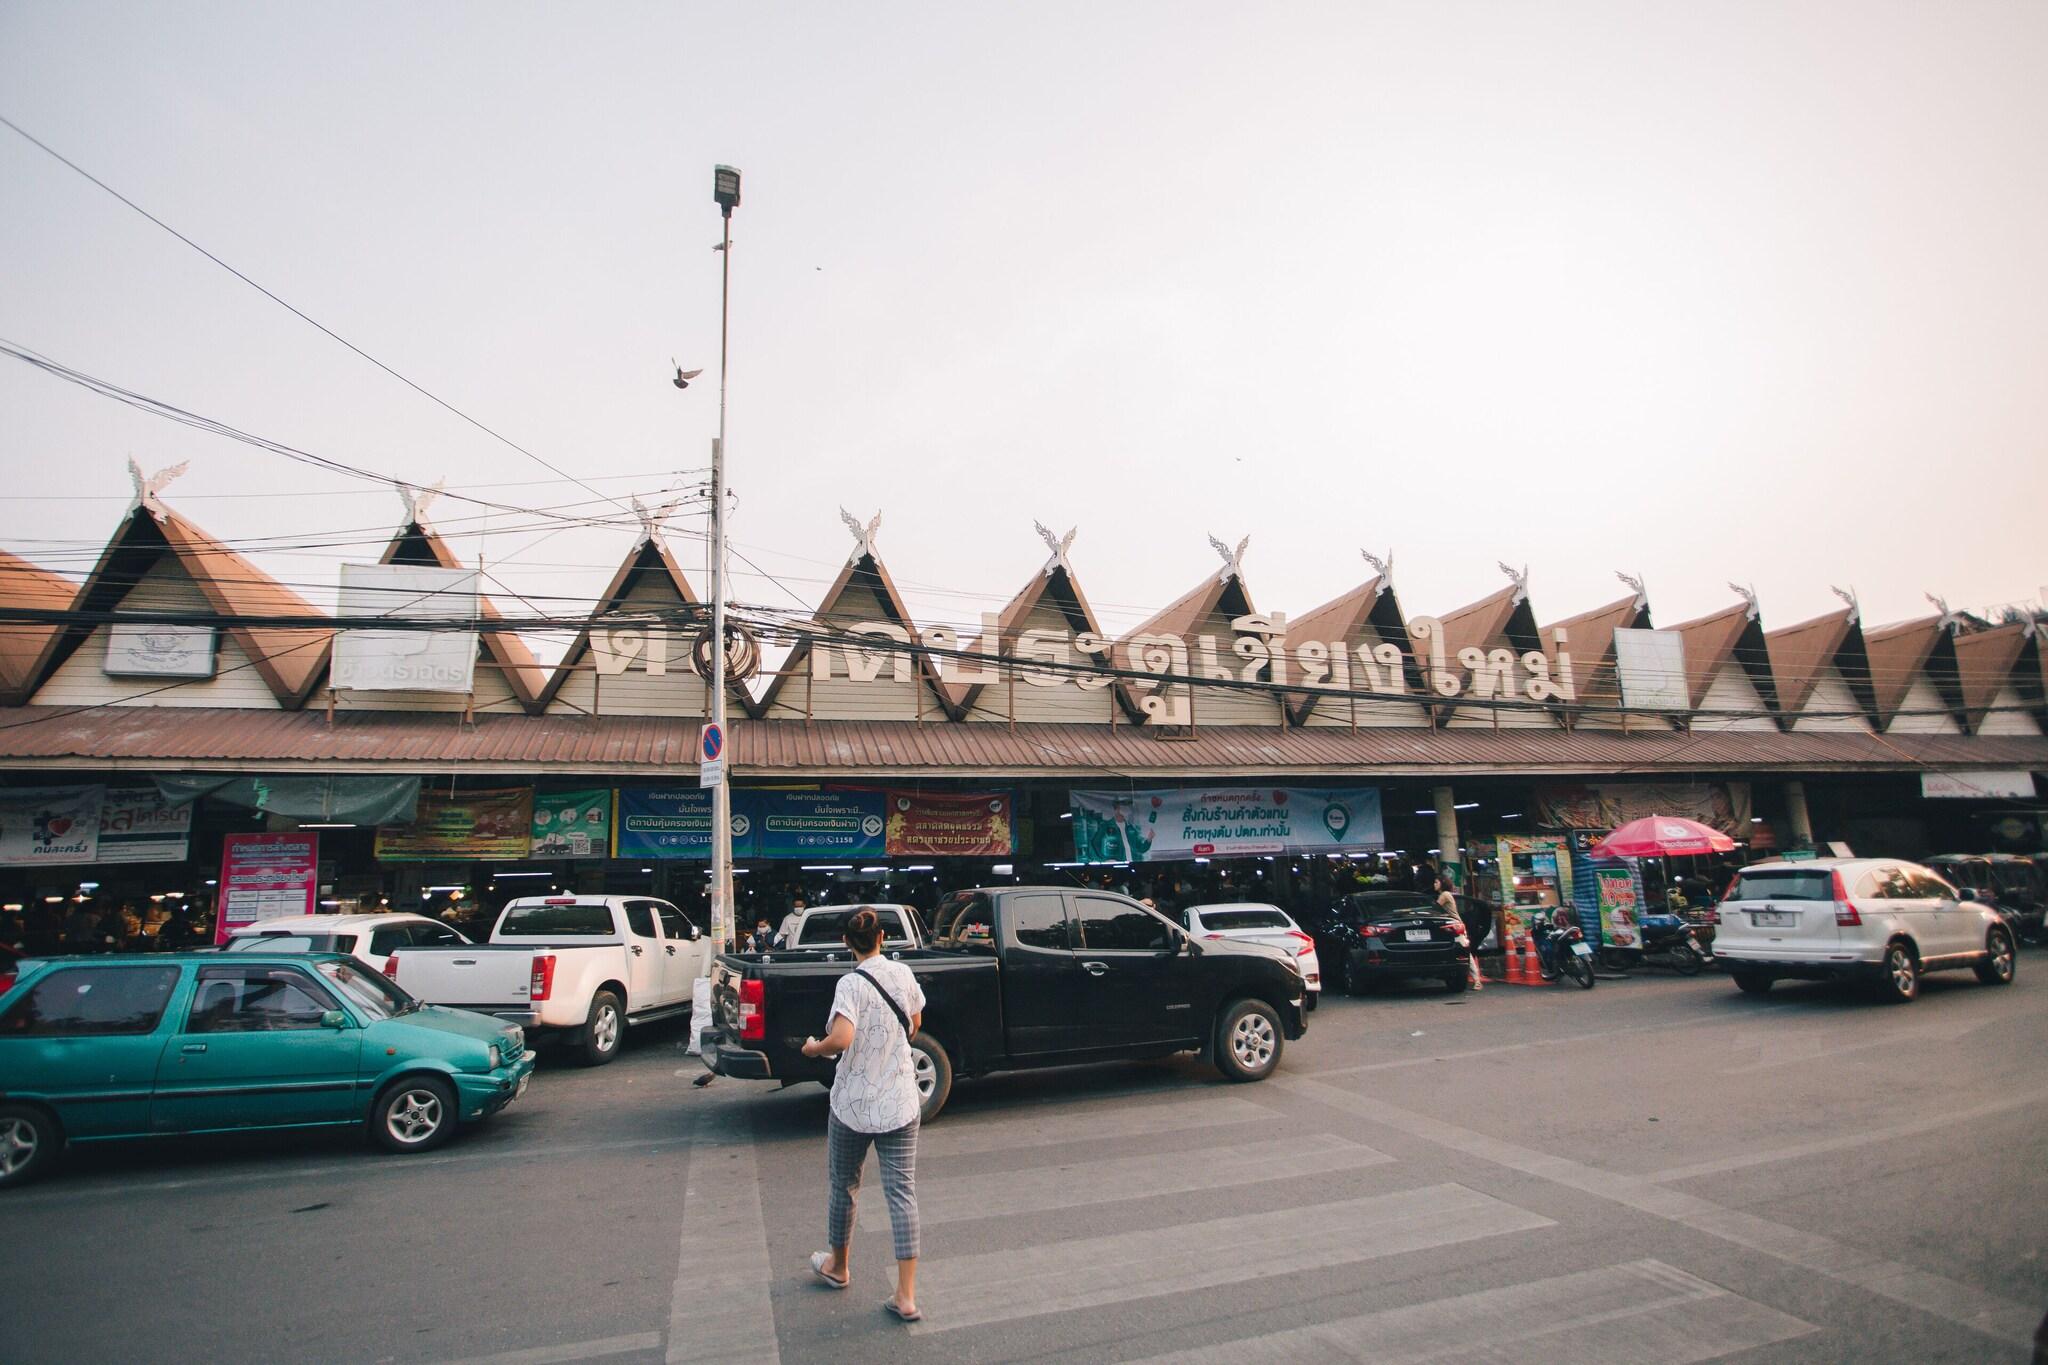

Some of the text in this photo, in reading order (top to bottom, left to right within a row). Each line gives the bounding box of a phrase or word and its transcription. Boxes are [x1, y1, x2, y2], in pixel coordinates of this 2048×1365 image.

[1182, 803, 1289, 822] สั่งกับร้านค้าตัวแทน
[835, 836, 854, 844] 1158
